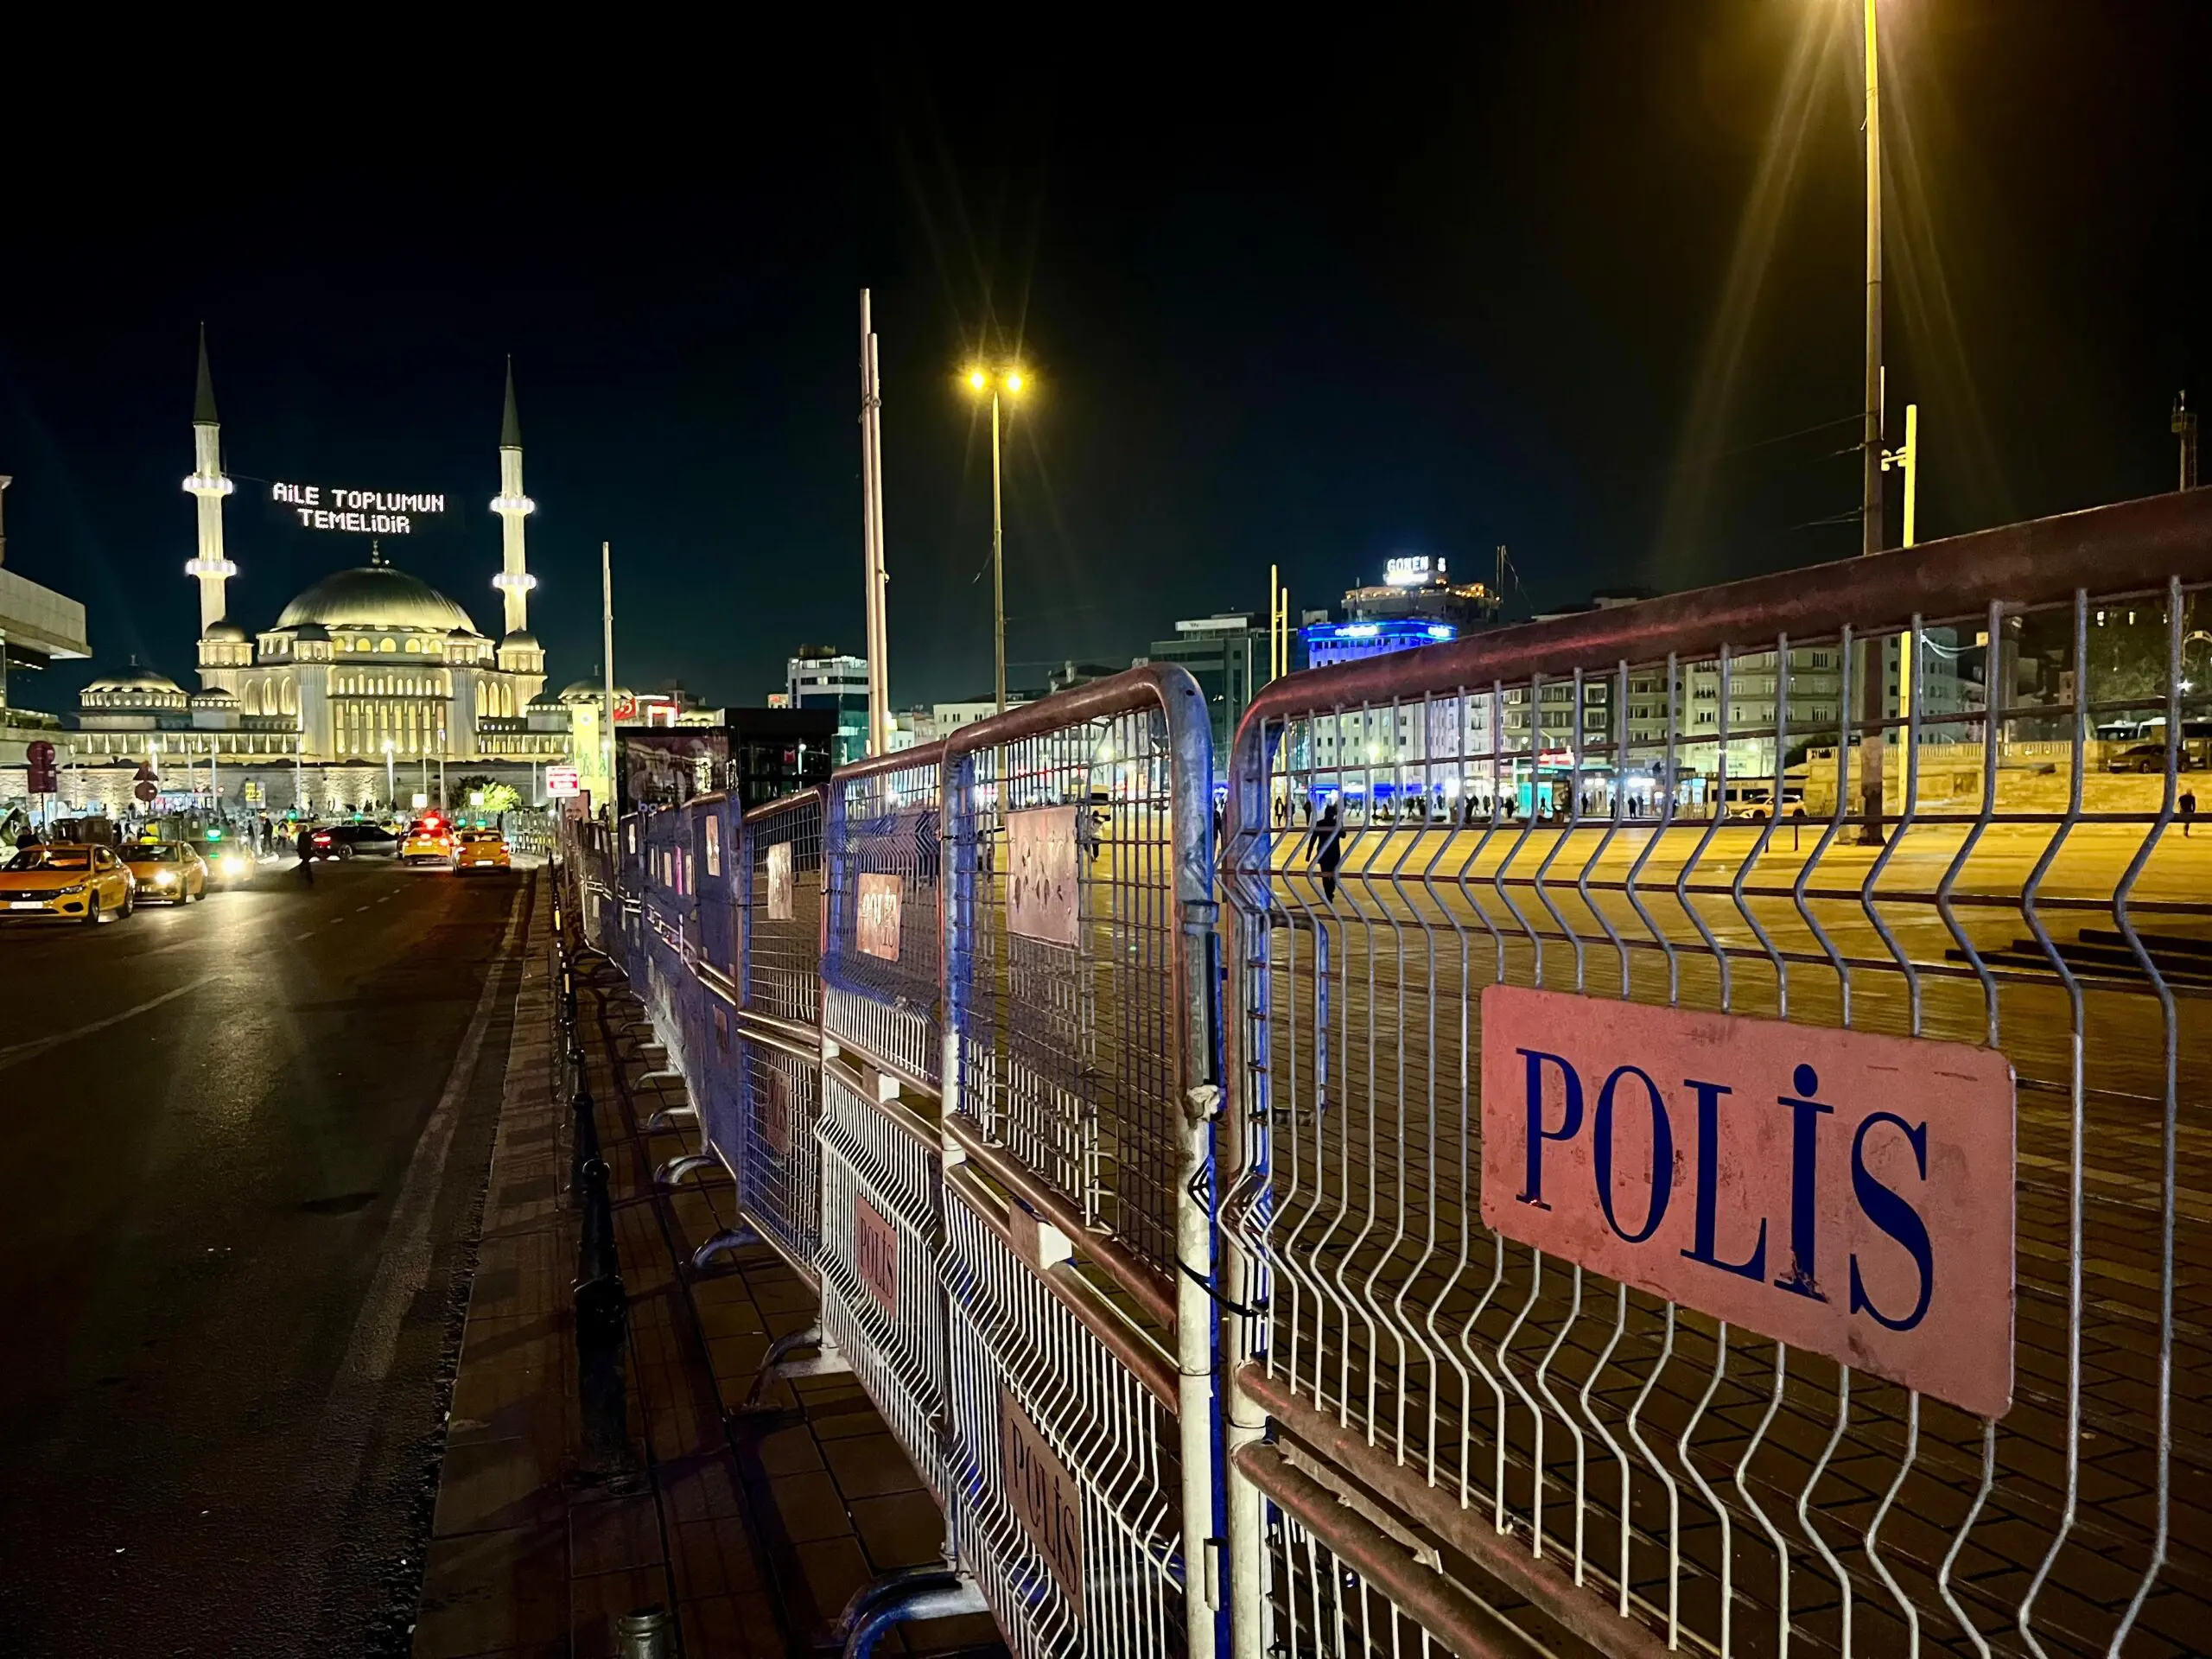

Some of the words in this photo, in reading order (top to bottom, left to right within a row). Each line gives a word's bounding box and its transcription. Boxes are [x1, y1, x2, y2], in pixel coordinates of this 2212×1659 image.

[331, 489, 444, 512] TOPLUMUN
[1516, 1046, 1934, 1332] POLİS
[860, 1216, 893, 1299] POLİS
[1010, 1417, 1077, 1596] POLİS
